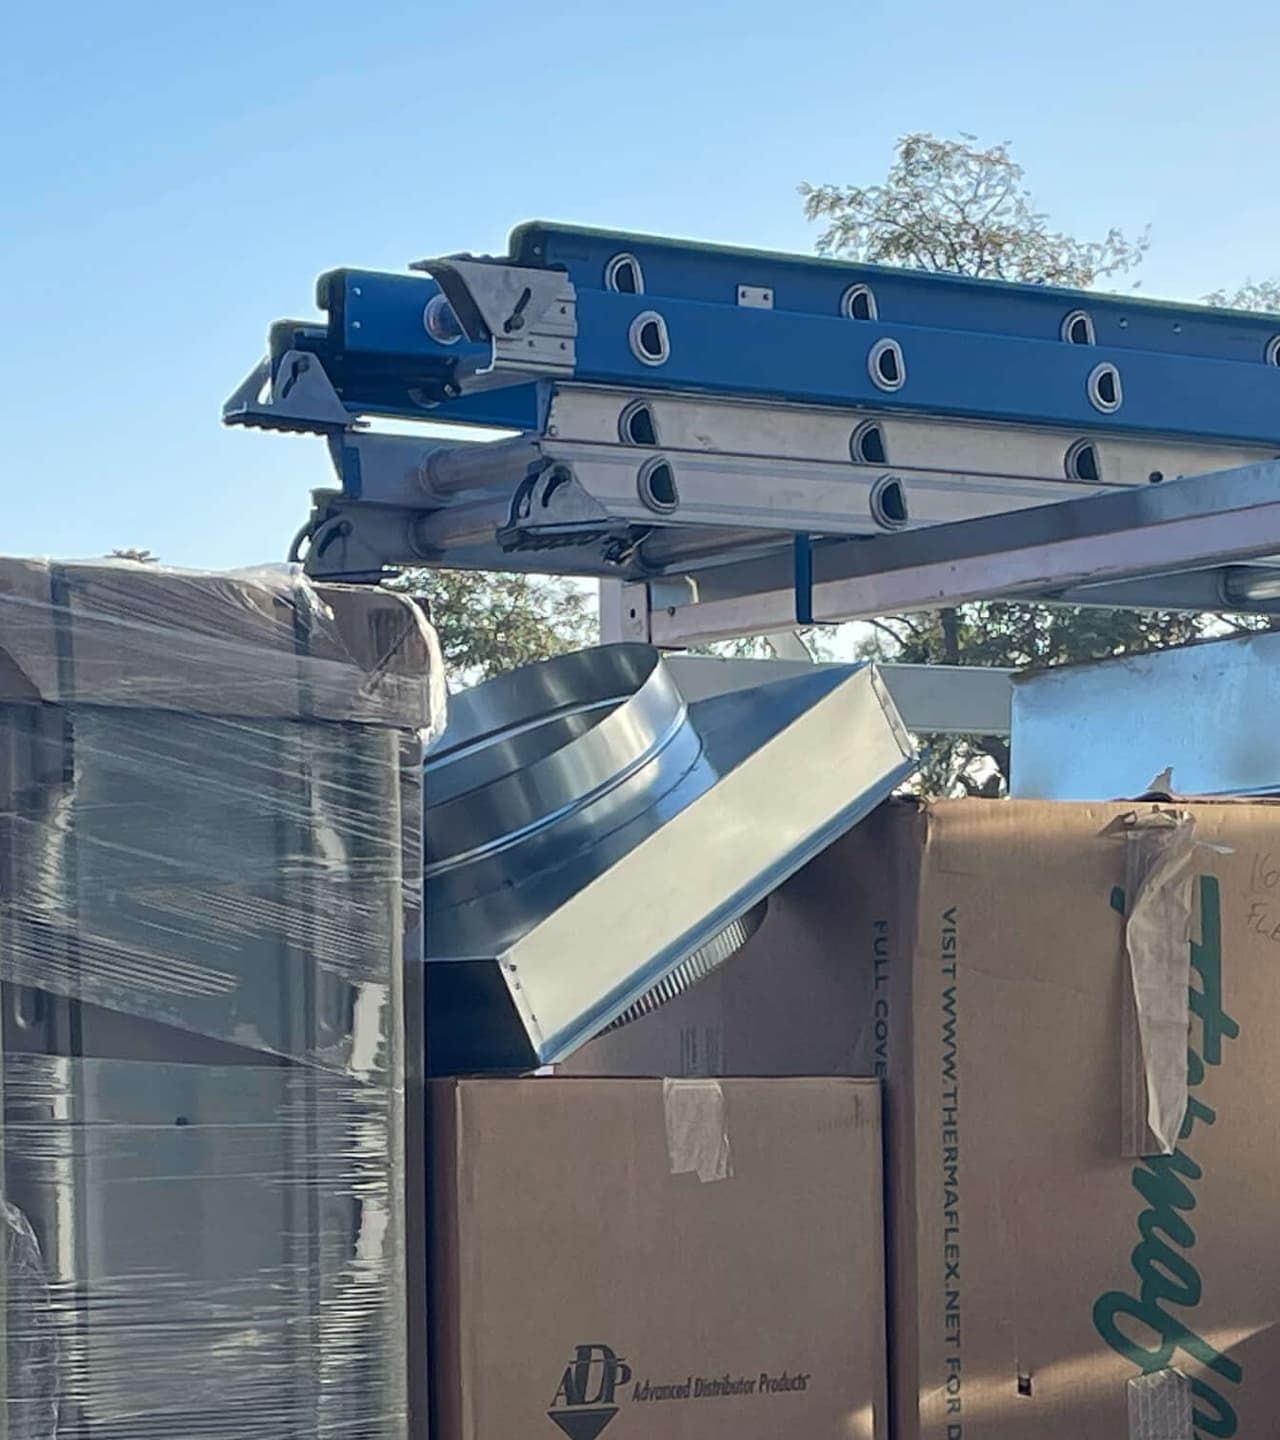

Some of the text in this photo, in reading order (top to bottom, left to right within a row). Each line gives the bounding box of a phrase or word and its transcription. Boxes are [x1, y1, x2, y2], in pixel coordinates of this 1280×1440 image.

[873, 919, 889, 990] FULL
[941, 906, 958, 980] VISIT
[941, 987, 961, 1347] WWW.THERMAFLEX.NET
[550, 1344, 633, 1407] ADP
[632, 1376, 692, 1402] Advanced
[694, 1373, 756, 1398] Distributor
[945, 1356, 962, 1414] FOR
